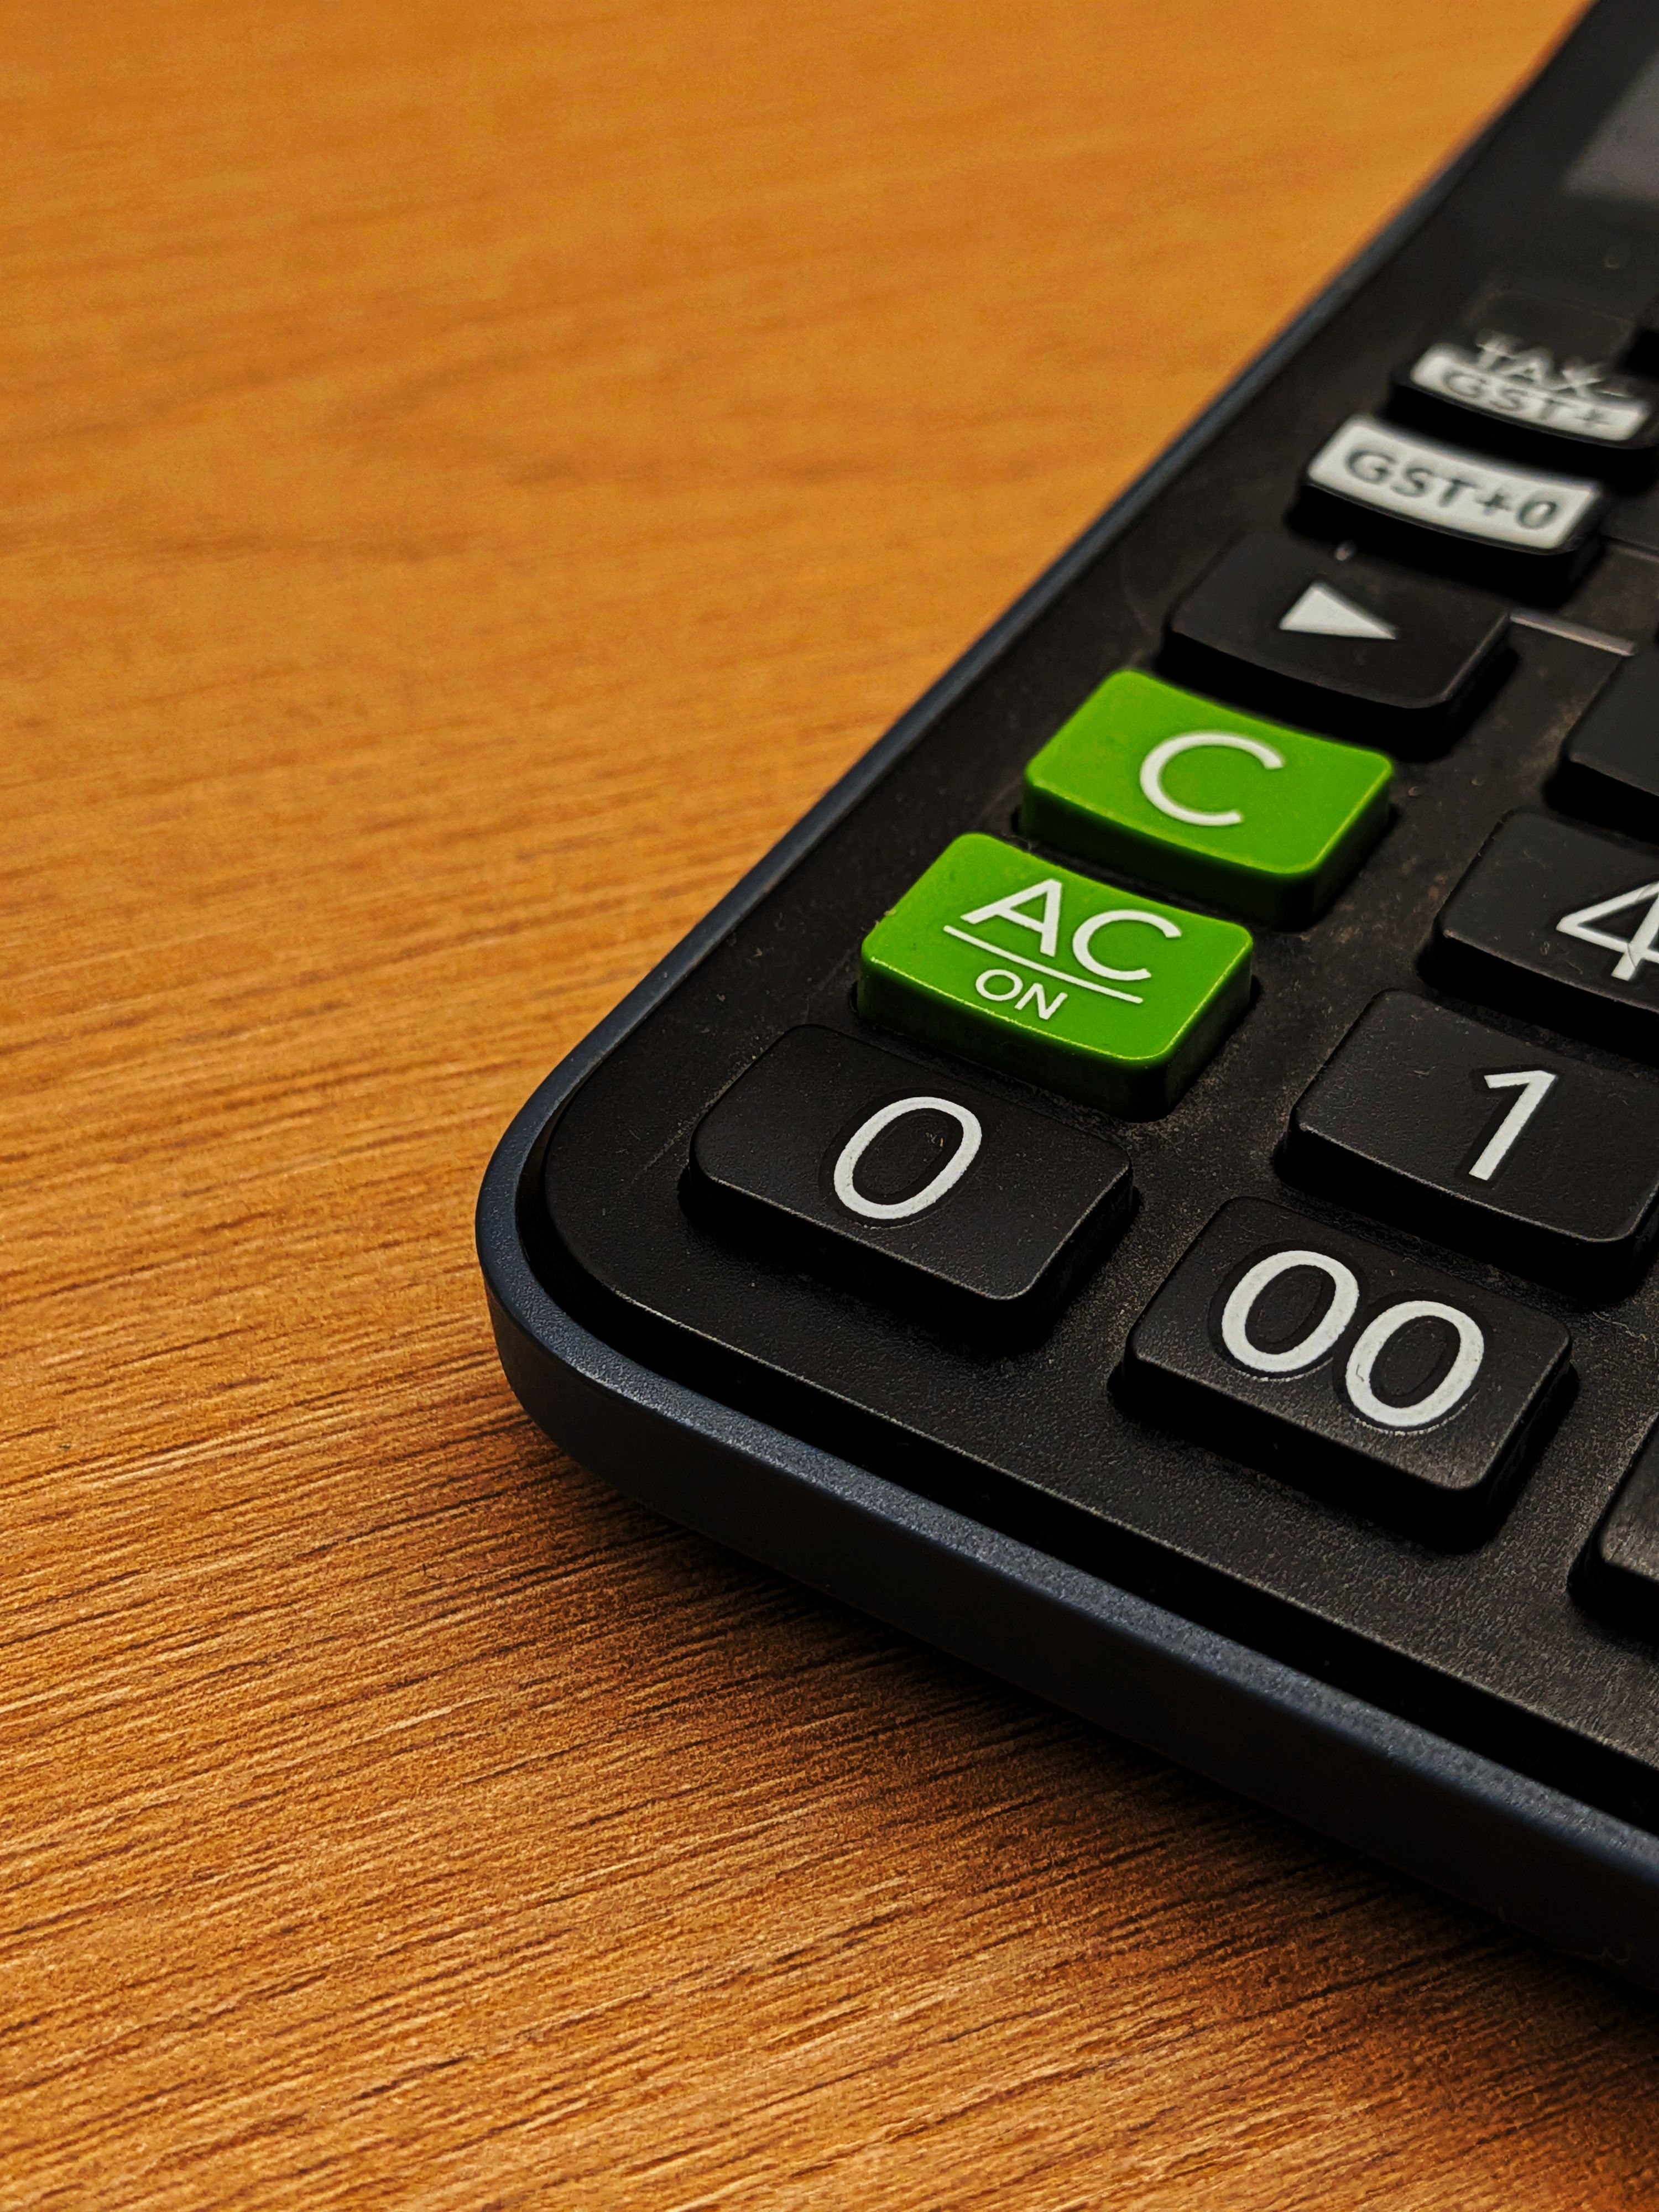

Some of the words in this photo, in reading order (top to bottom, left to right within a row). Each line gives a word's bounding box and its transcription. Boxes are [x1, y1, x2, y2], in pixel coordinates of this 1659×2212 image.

[1442, 369, 1615, 429] GST+
[1344, 448, 1558, 529] GST+0
[1140, 731, 1285, 826] C
[961, 878, 1182, 981] AC
[1556, 879, 1659, 981] 4
[975, 968, 1068, 1020] ON
[833, 1096, 983, 1220] 0
[1468, 1070, 1557, 1181] 1
[1220, 1250, 1485, 1427] 00
